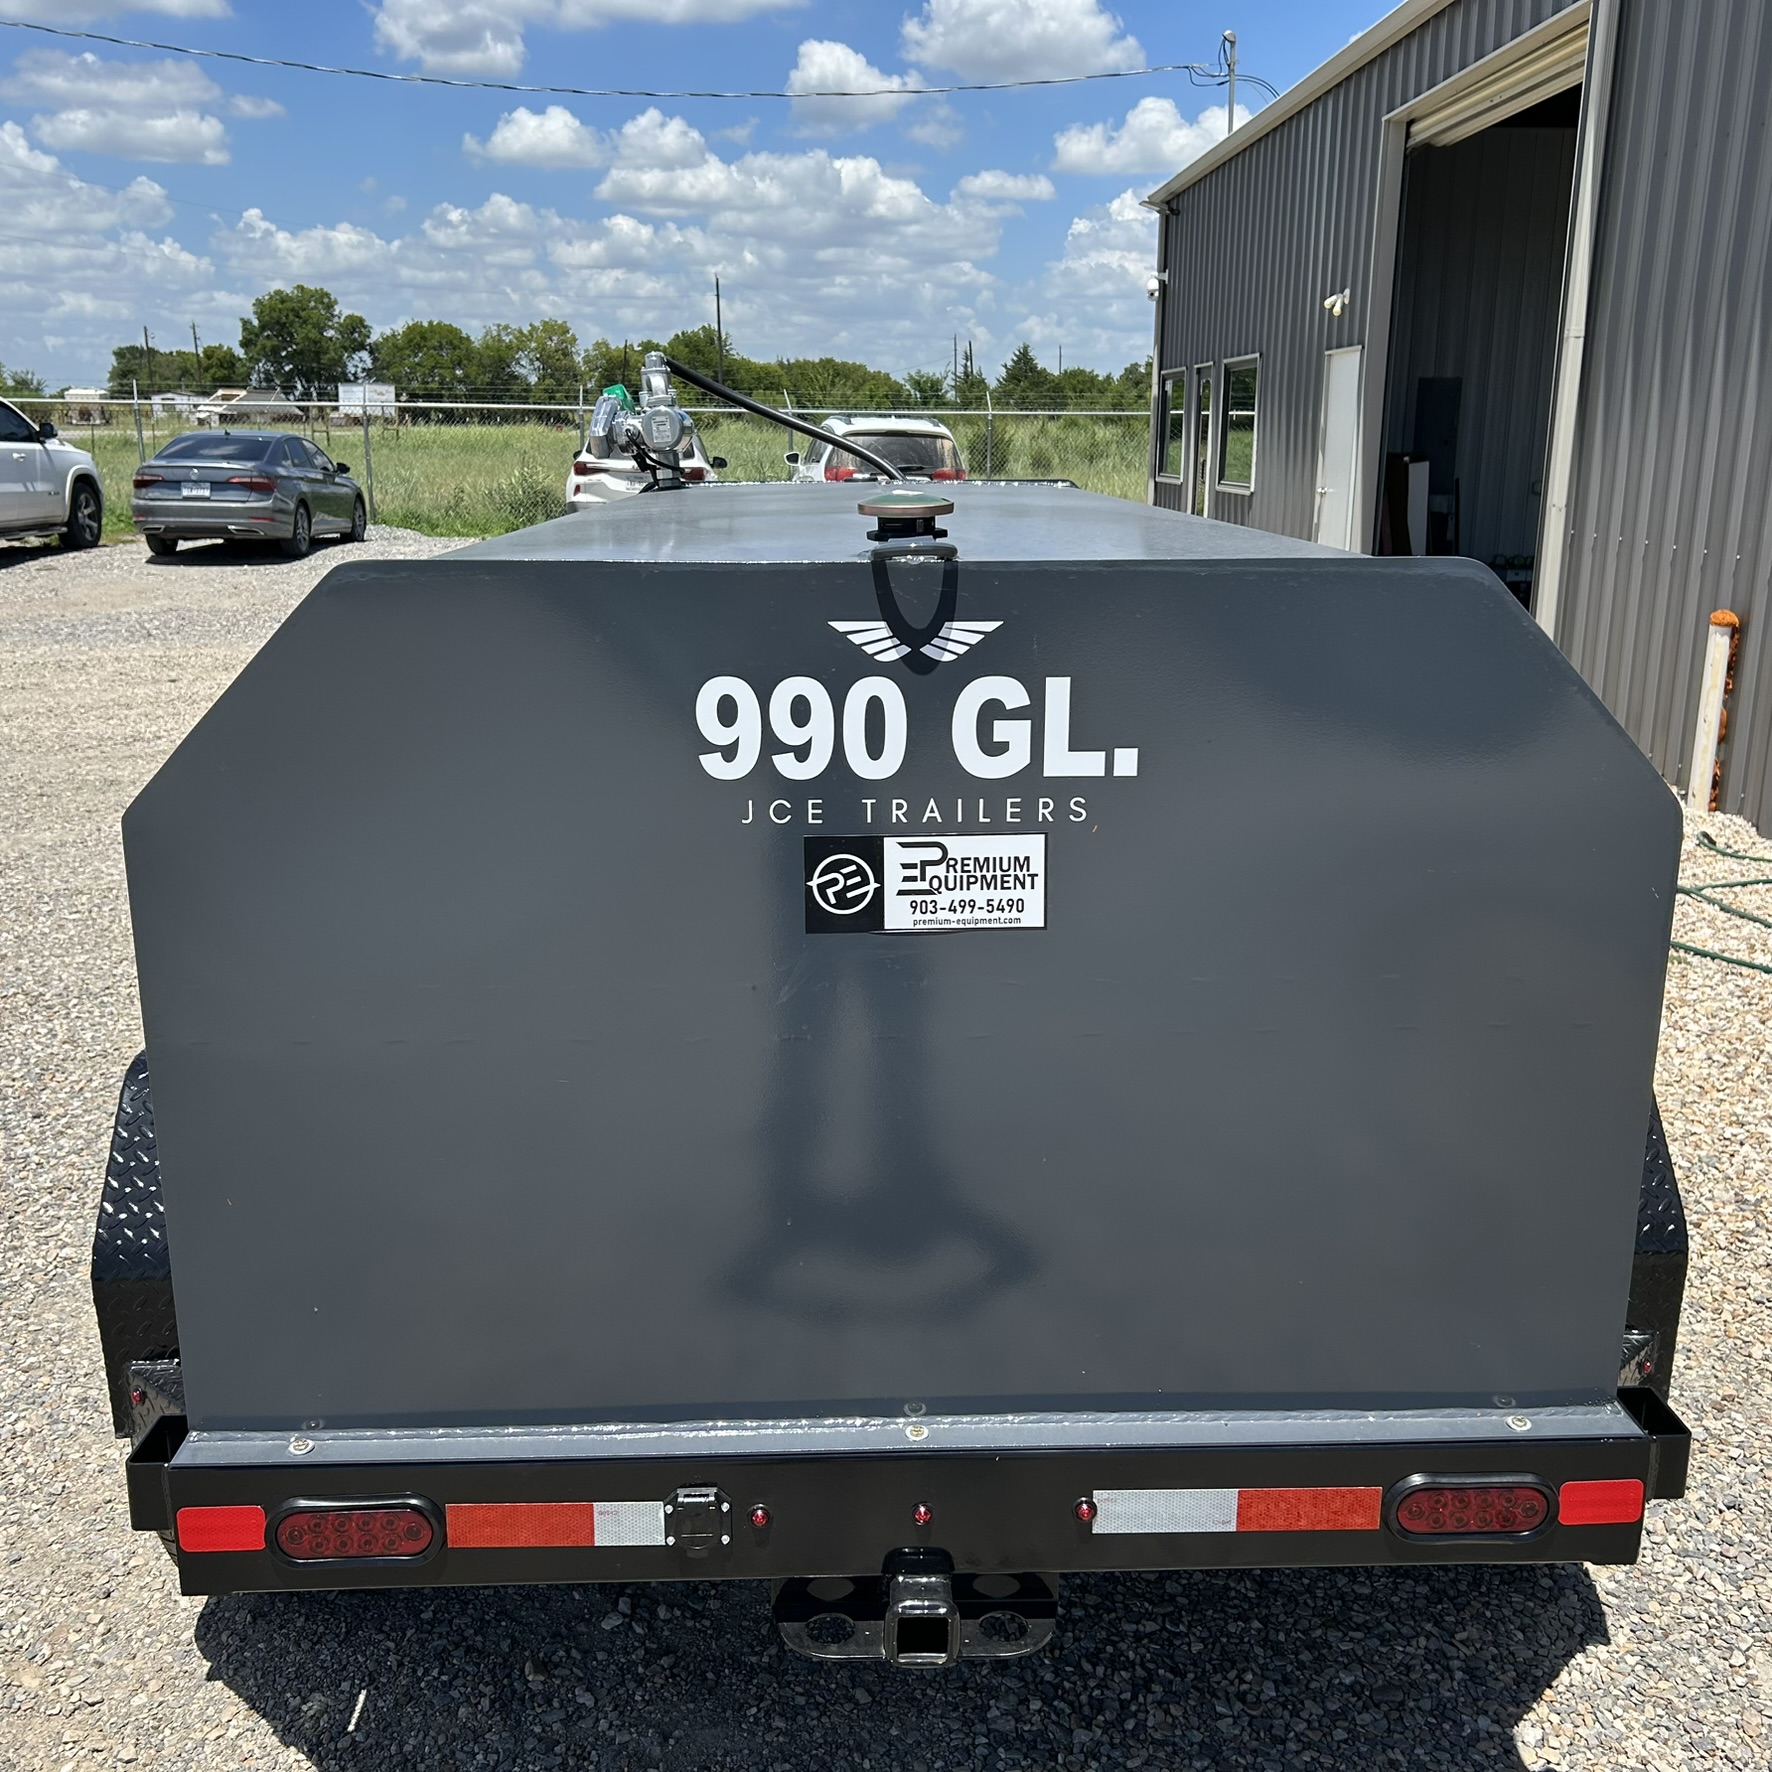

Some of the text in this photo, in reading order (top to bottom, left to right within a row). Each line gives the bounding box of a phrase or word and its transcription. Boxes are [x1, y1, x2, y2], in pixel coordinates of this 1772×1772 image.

[695, 675, 1139, 781] 990 GL.
[741, 796, 1088, 825] JCE TRAILERS
[909, 898, 1025, 915] 903-499-5490
[912, 916, 1022, 928] premium-equipment.com
